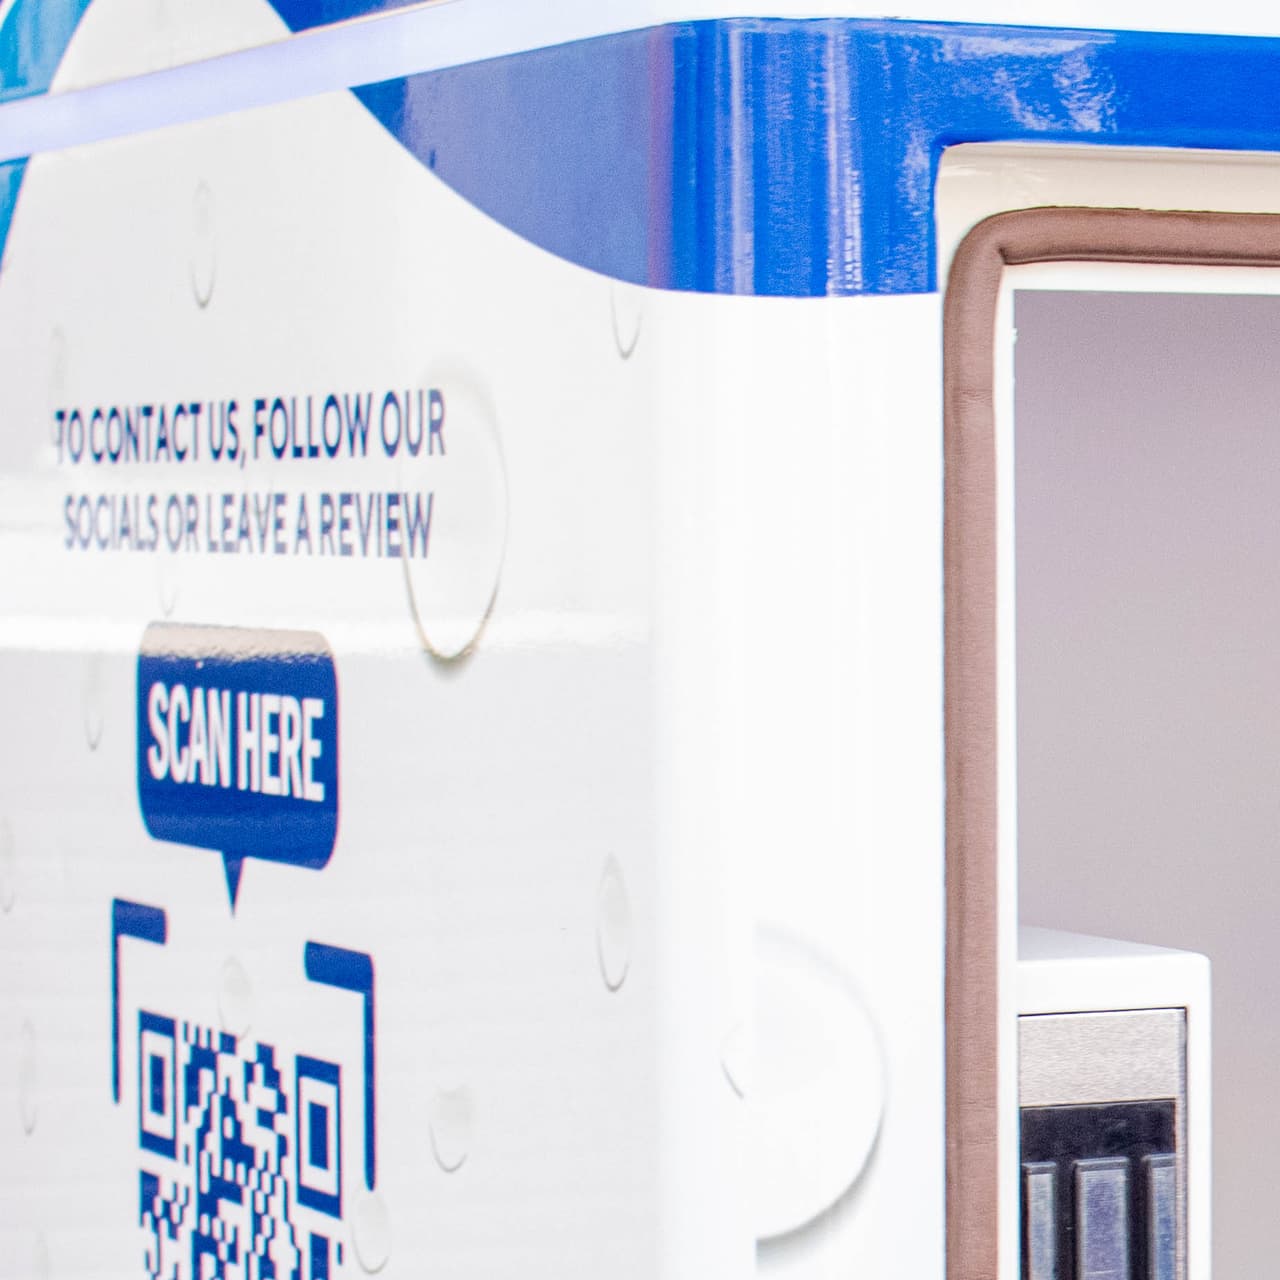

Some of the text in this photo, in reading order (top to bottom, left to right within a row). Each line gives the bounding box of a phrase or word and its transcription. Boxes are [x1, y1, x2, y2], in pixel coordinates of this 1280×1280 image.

[54, 388, 446, 468] TO CONTACT US, FOLLOW OUR
[64, 493, 435, 558] SOCIALS OR LEAVE A REVIEW
[147, 681, 325, 803] SCAN HERE
